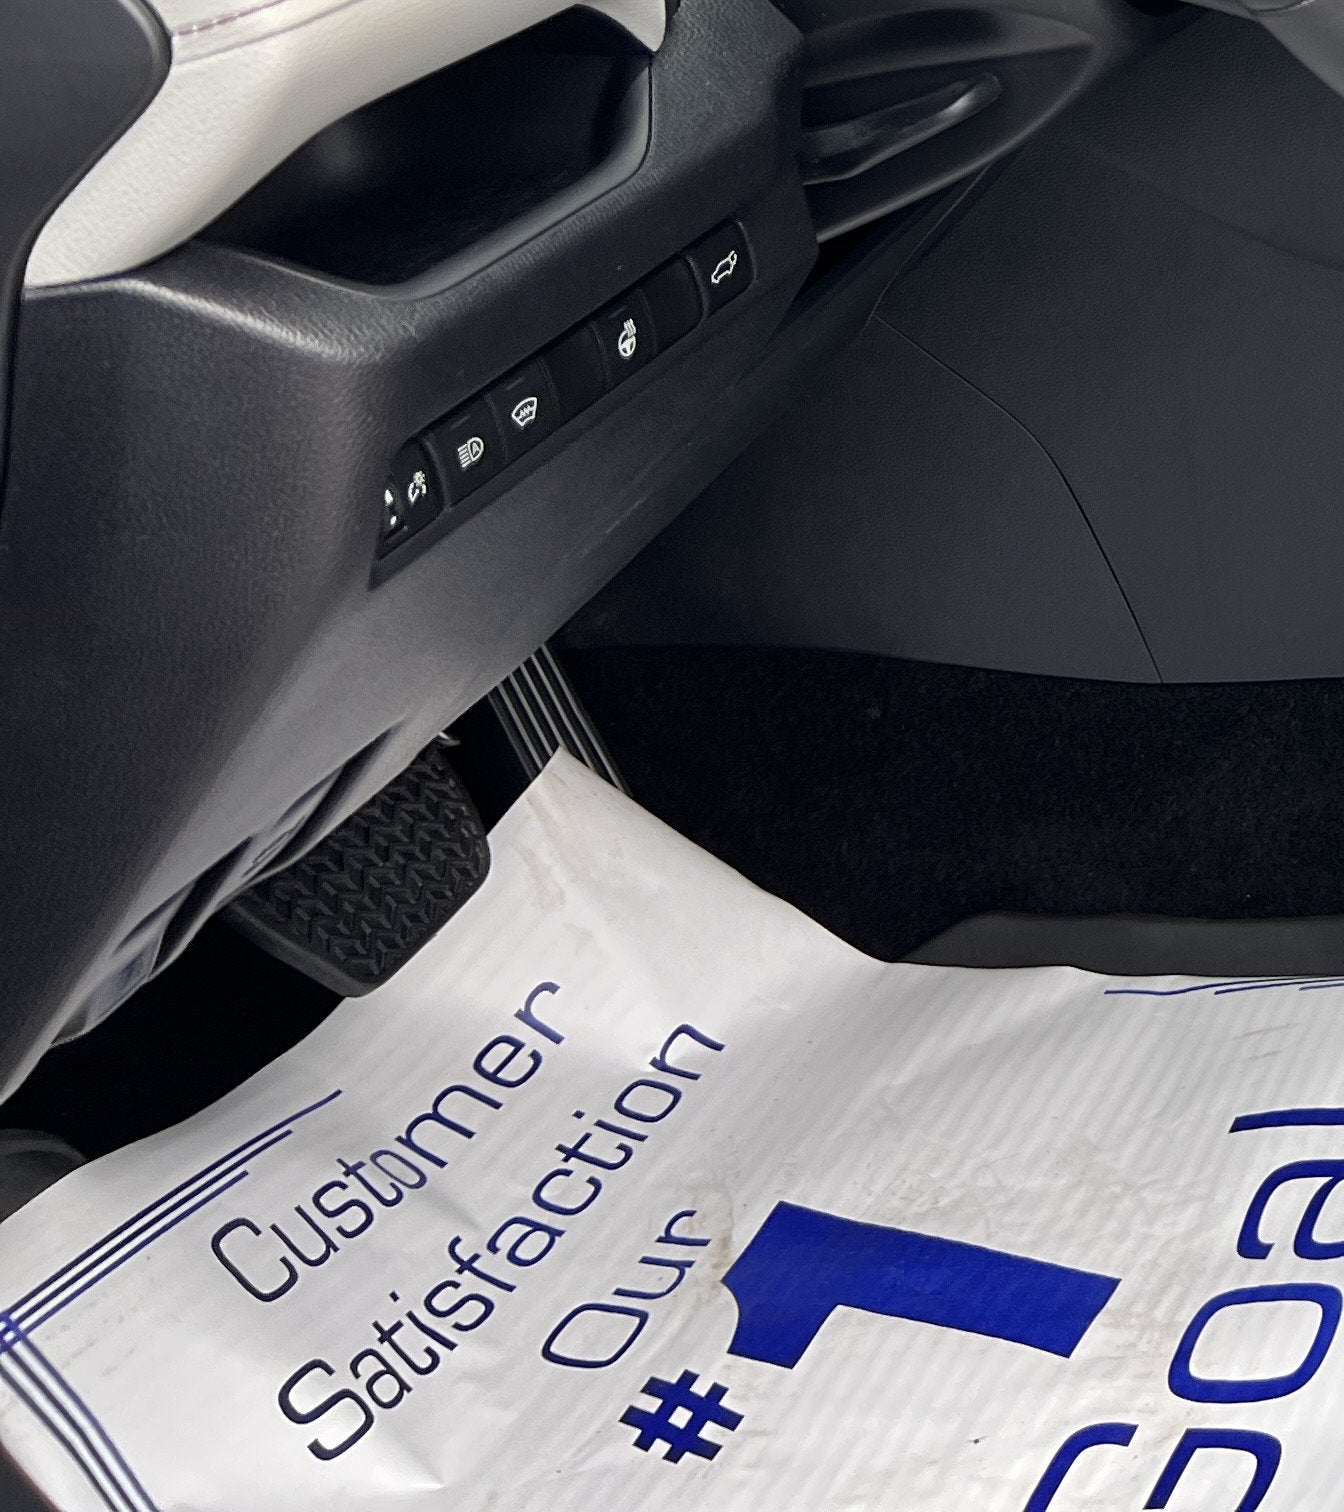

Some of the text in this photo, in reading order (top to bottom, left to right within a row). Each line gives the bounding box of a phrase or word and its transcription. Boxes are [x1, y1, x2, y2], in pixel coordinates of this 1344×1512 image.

[209, 980, 565, 1303] Customer
[277, 1022, 727, 1462] Satisfaction
[540, 1208, 714, 1370] Our
